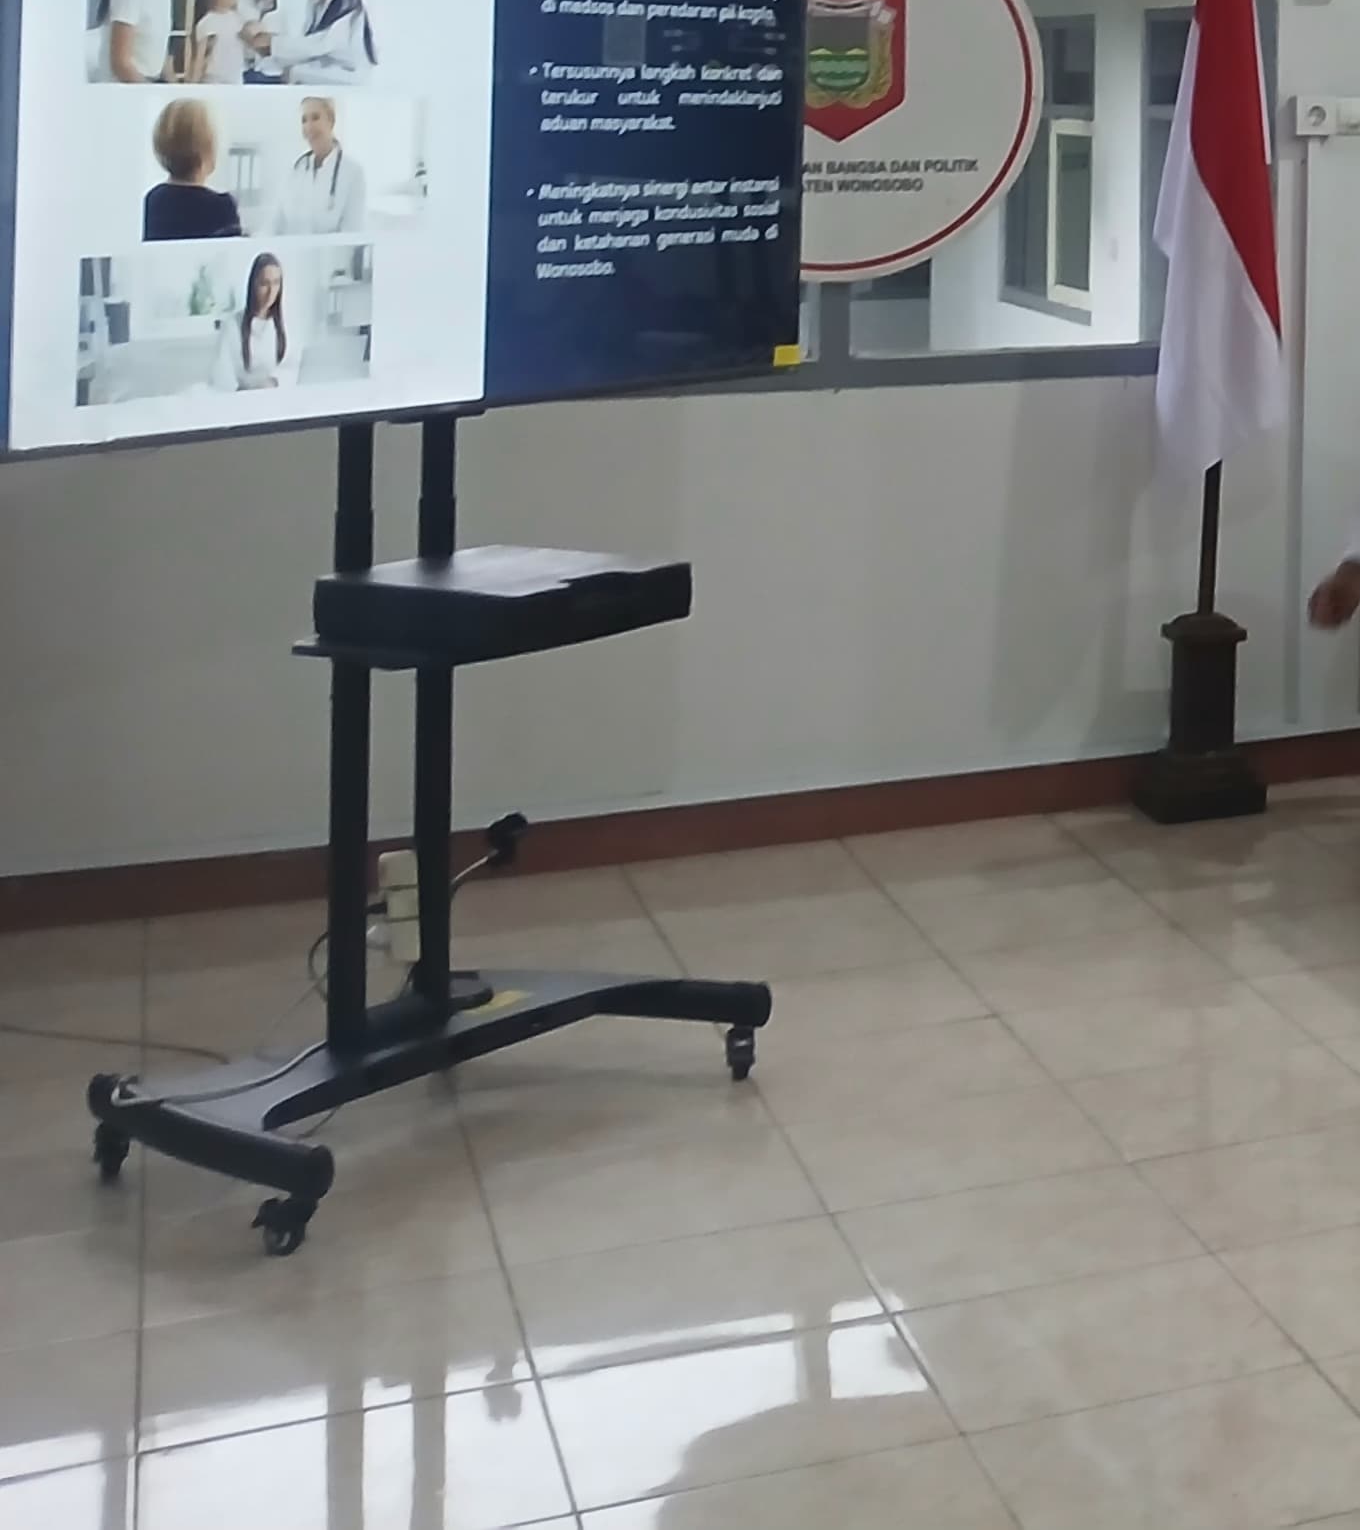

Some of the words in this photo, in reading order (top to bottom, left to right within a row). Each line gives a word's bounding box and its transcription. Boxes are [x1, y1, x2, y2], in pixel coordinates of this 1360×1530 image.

[559, 0, 614, 16] medsos
[617, 0, 645, 16] dan
[647, 3, 717, 20] peredaran
[543, 62, 635, 84] Tersusunnya
[641, 64, 696, 86] langkah
[701, 65, 752, 81] konkret
[757, 66, 783, 81] dan
[541, 90, 598, 105] terukur
[618, 90, 661, 105] untuk
[679, 90, 782, 110] menindaklanjuti
[541, 115, 587, 131] aduan
[826, 161, 888, 174] BANGSA
[890, 160, 921, 173] DAN
[924, 159, 978, 172] POLITIK
[539, 182, 640, 204] Meningkatnya
[691, 180, 728, 195] antar
[837, 178, 924, 192] WONOSOBO
[538, 209, 582, 226] untuk
[588, 207, 649, 227] menjaga
[537, 236, 567, 252] dan
[574, 233, 650, 250] ketahanan
[656, 226, 715, 251] generasi
[721, 225, 759, 241] muda
[765, 223, 779, 239] di
